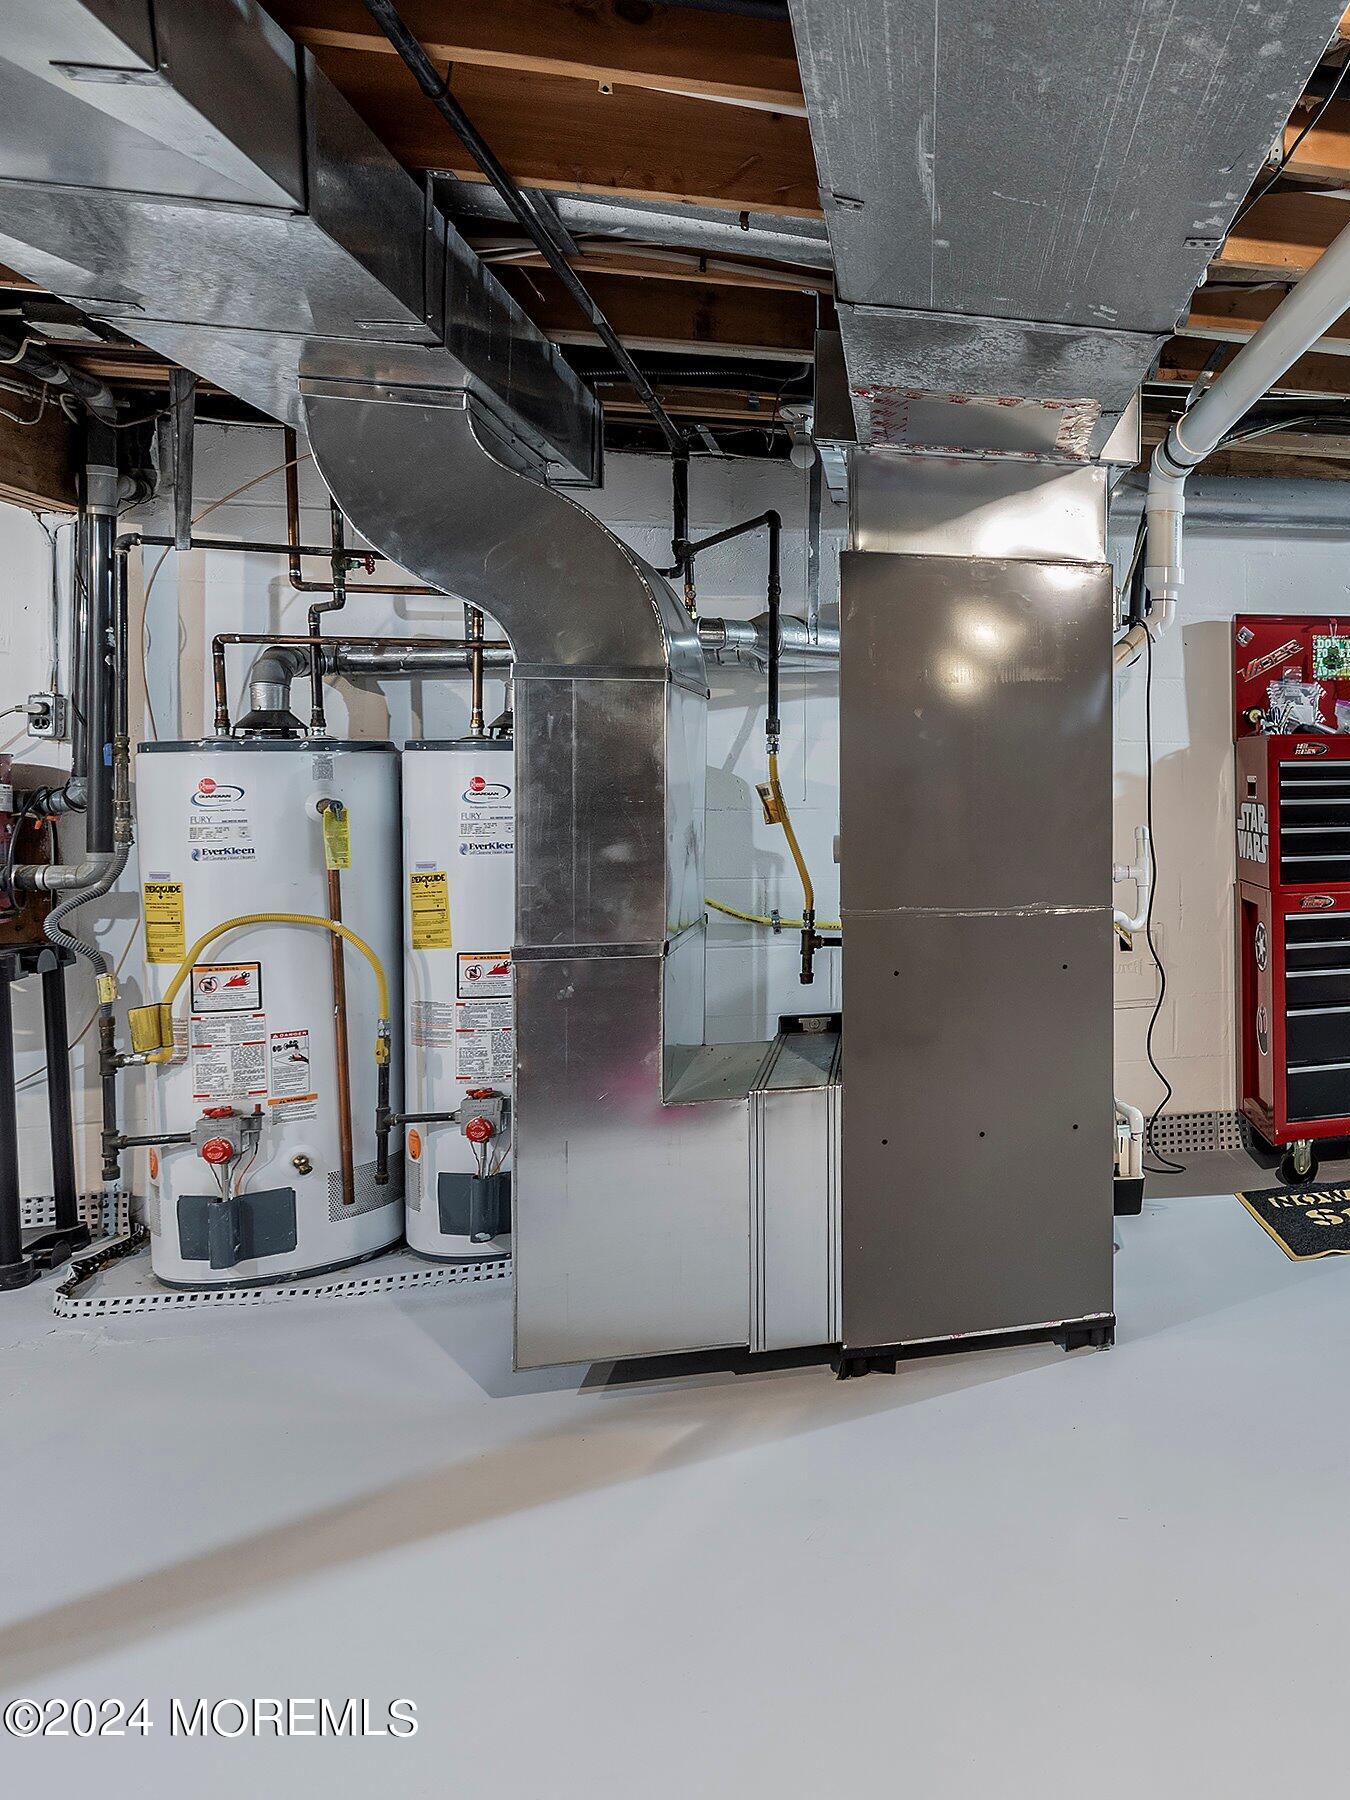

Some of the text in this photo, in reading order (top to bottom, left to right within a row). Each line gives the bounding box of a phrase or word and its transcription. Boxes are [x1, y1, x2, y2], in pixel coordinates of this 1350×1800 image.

[1237, 802, 1268, 834] STAR
[202, 846, 255, 856] EverKleen
[1237, 830, 1268, 863] WARS
[279, 1030, 308, 1039] DANGER
[1269, 1190, 1347, 1208] NOW
